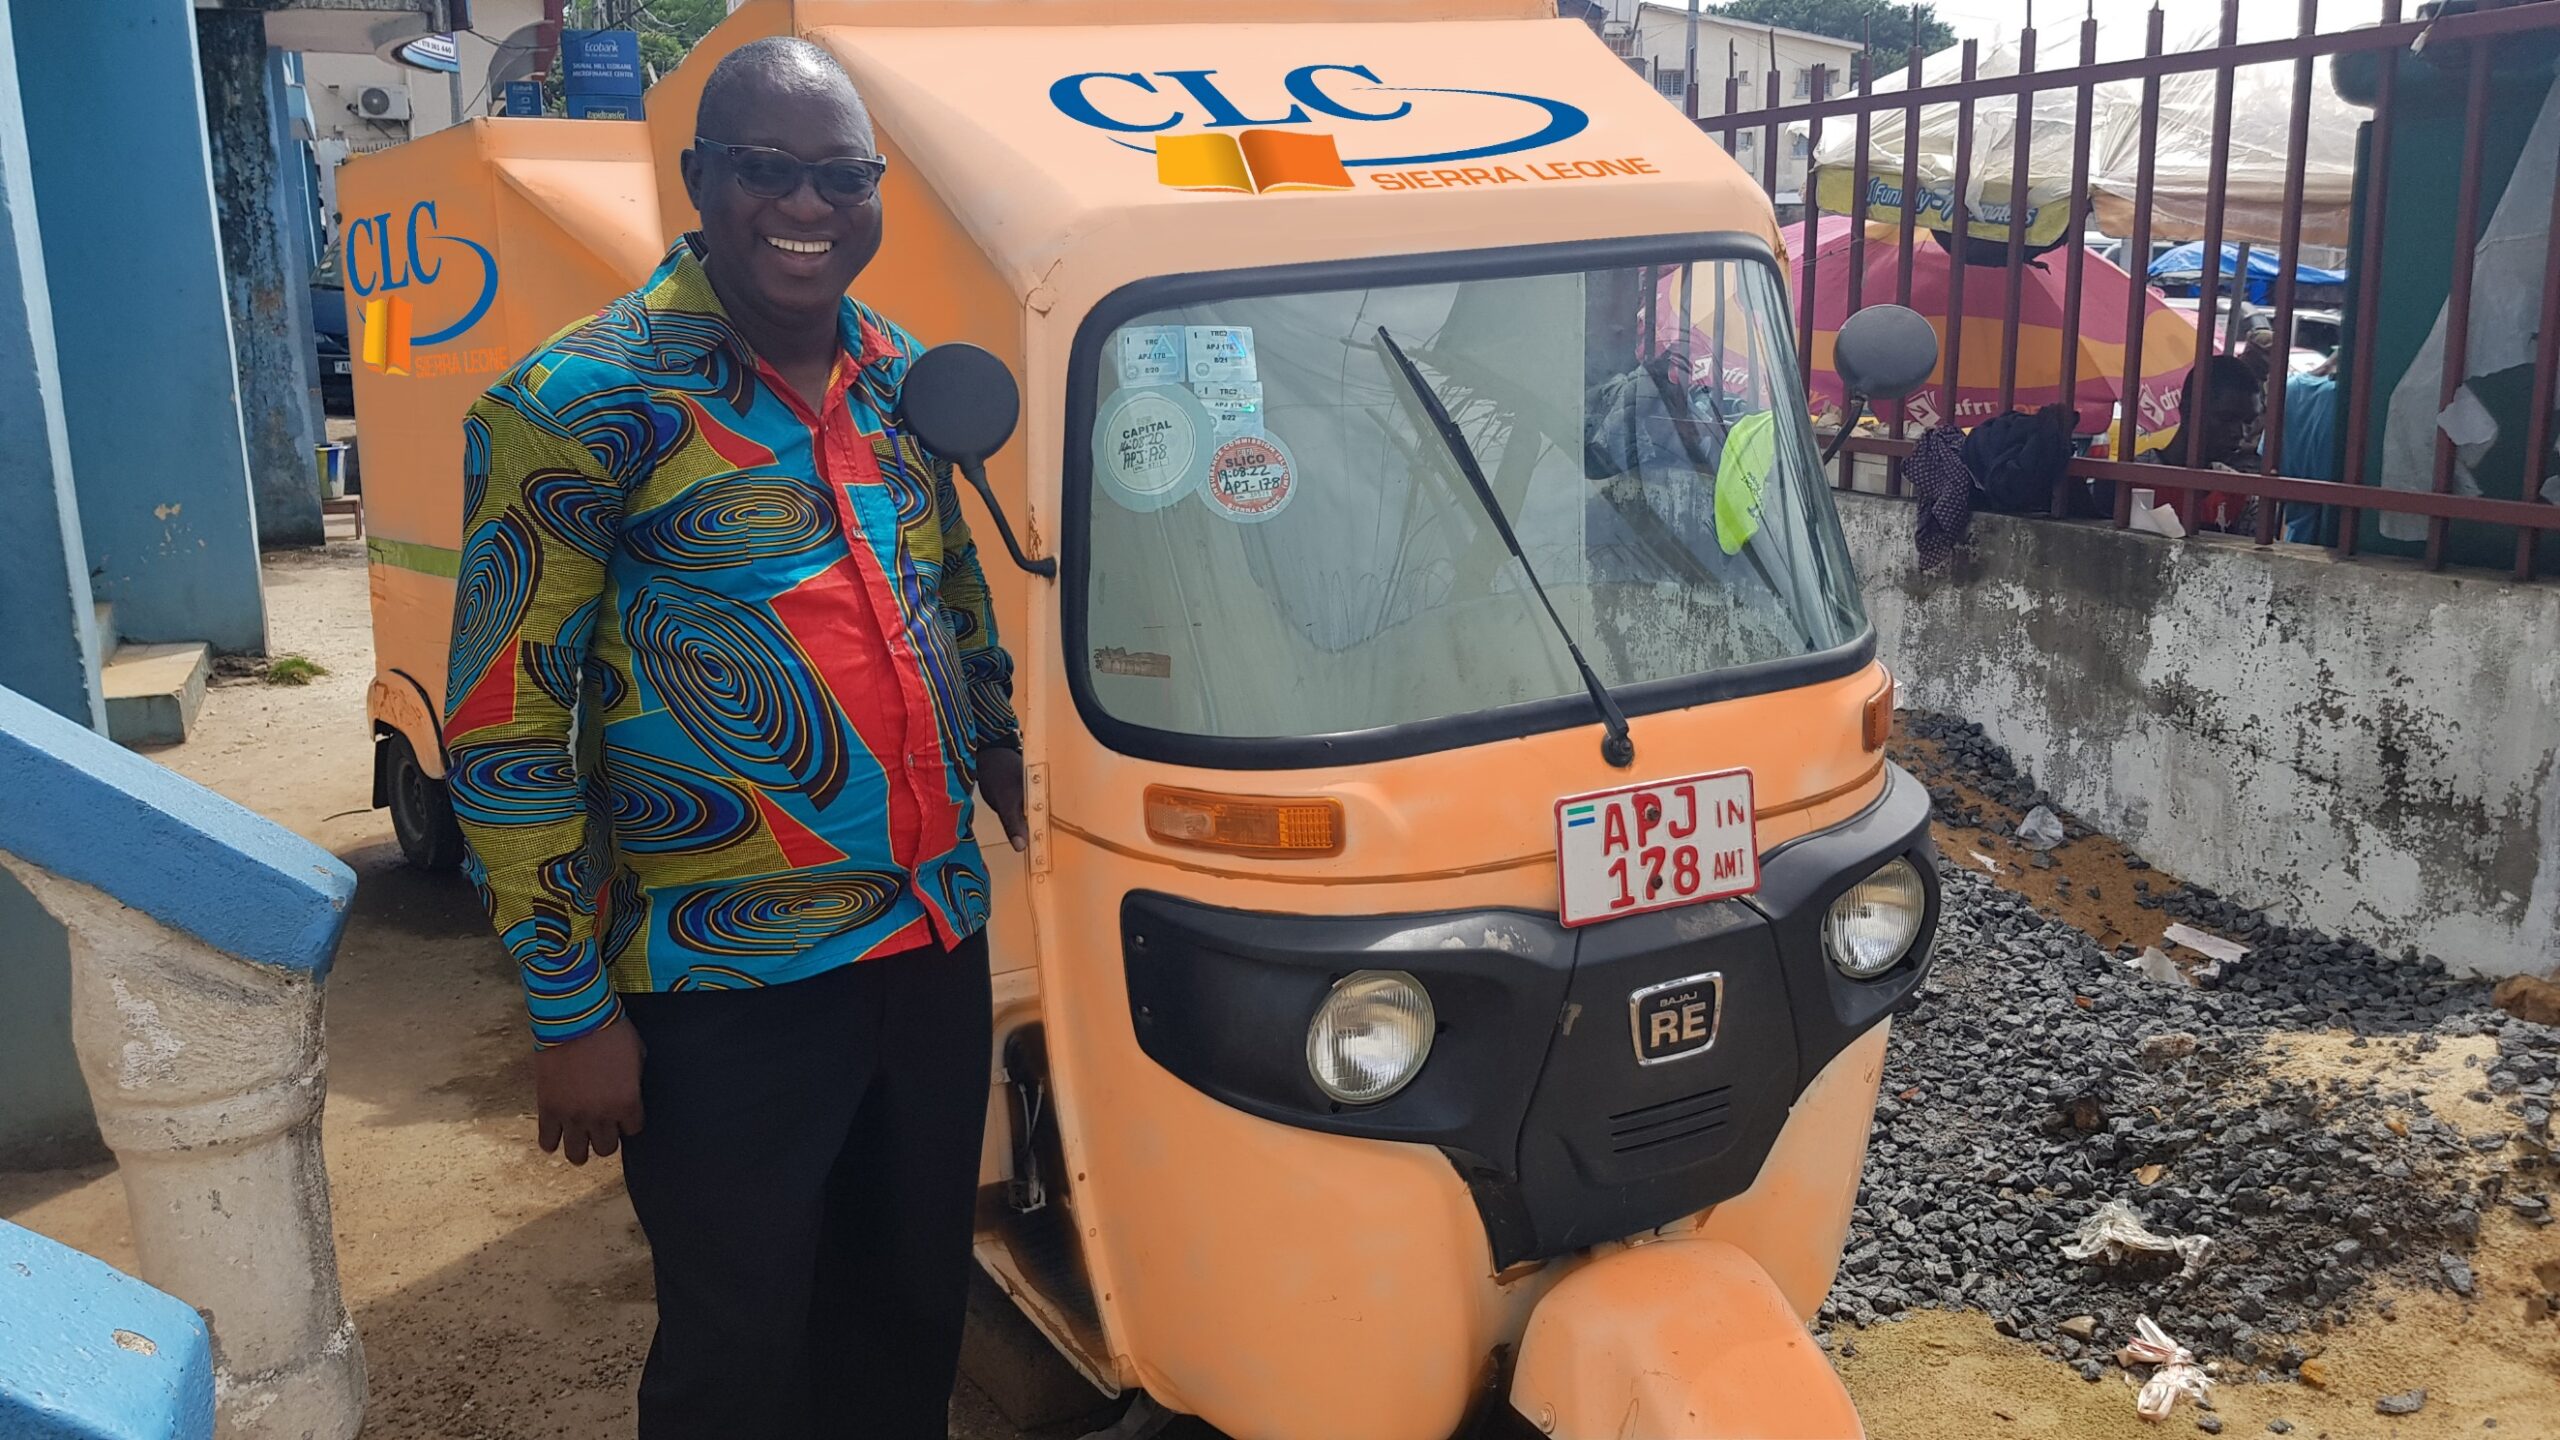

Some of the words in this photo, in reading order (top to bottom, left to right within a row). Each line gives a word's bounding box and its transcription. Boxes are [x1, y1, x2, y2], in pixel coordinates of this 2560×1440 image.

[585, 40, 618, 53] Ecobank
[572, 70, 612, 78] MICROFINANCE
[1049, 64, 1412, 132] CLC
[1370, 163, 1526, 192] SIERRA
[1527, 157, 1660, 183] LEONE
[347, 200, 442, 297] CLC
[415, 352, 461, 378] SIERRA
[464, 346, 510, 374] LEONE
[1122, 420, 1173, 439] CAPITAL
[1225, 454, 1266, 468] SLICO
[1604, 785, 1697, 856] APJ
[1715, 798, 1745, 828] IN
[1608, 845, 1700, 909] 178
[1713, 848, 1744, 881] AMT
[1660, 991, 1697, 1008] BAJAJ
[1650, 1001, 1706, 1048] RE
